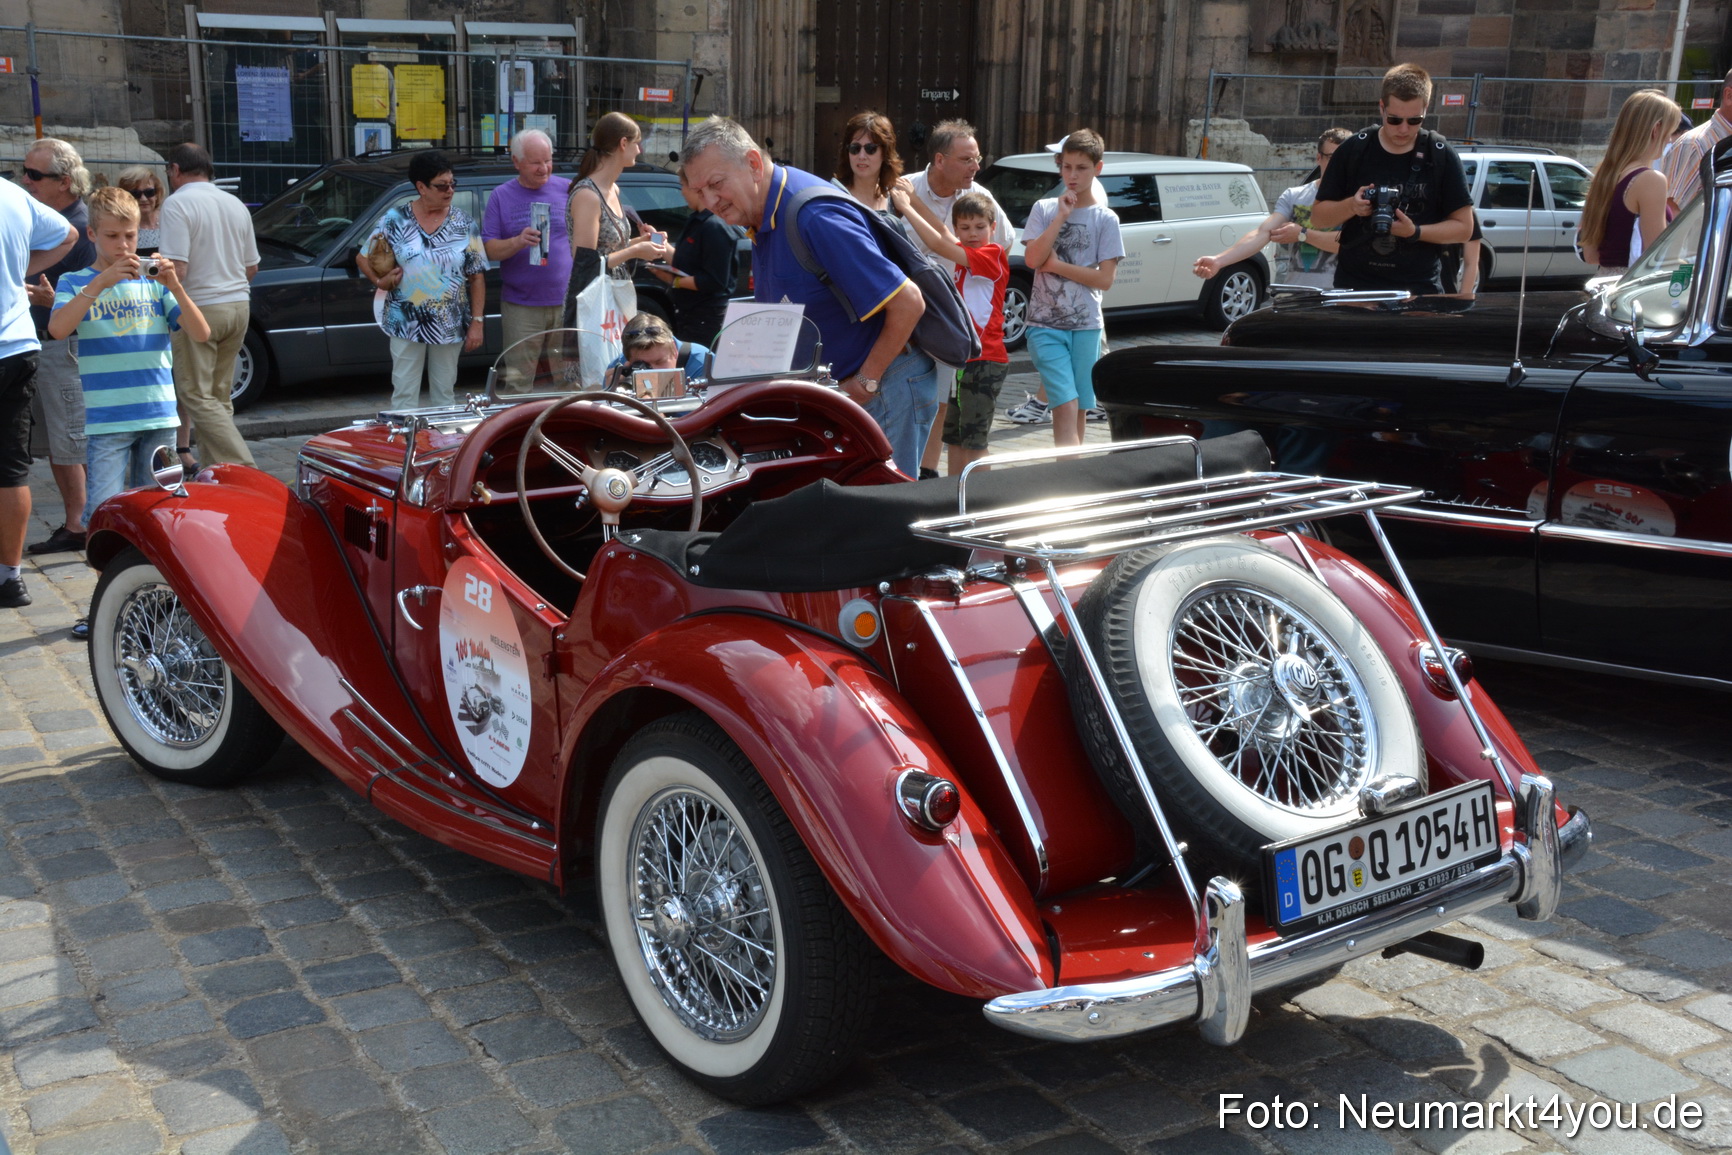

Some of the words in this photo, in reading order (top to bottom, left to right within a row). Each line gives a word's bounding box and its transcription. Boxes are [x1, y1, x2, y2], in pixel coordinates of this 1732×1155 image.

[921, 88, 951, 101] Eingang
[1196, 183, 1201, 191] &
[1202, 182, 1222, 191] BAYER
[1168, 551, 1259, 592] Firestone
[464, 572, 493, 614] 28
[455, 637, 468, 663] 100
[490, 634, 521, 657] MEILENSTEIN
[1295, 663, 1317, 686] MG
[515, 714, 528, 727] DEKRA
[1284, 891, 1294, 908] D
[1301, 842, 1347, 905] OG
[1317, 912, 1335, 925] K.H.
[1336, 900, 1369, 919] DEUSCH
[1372, 885, 1412, 906] SEELBACH
